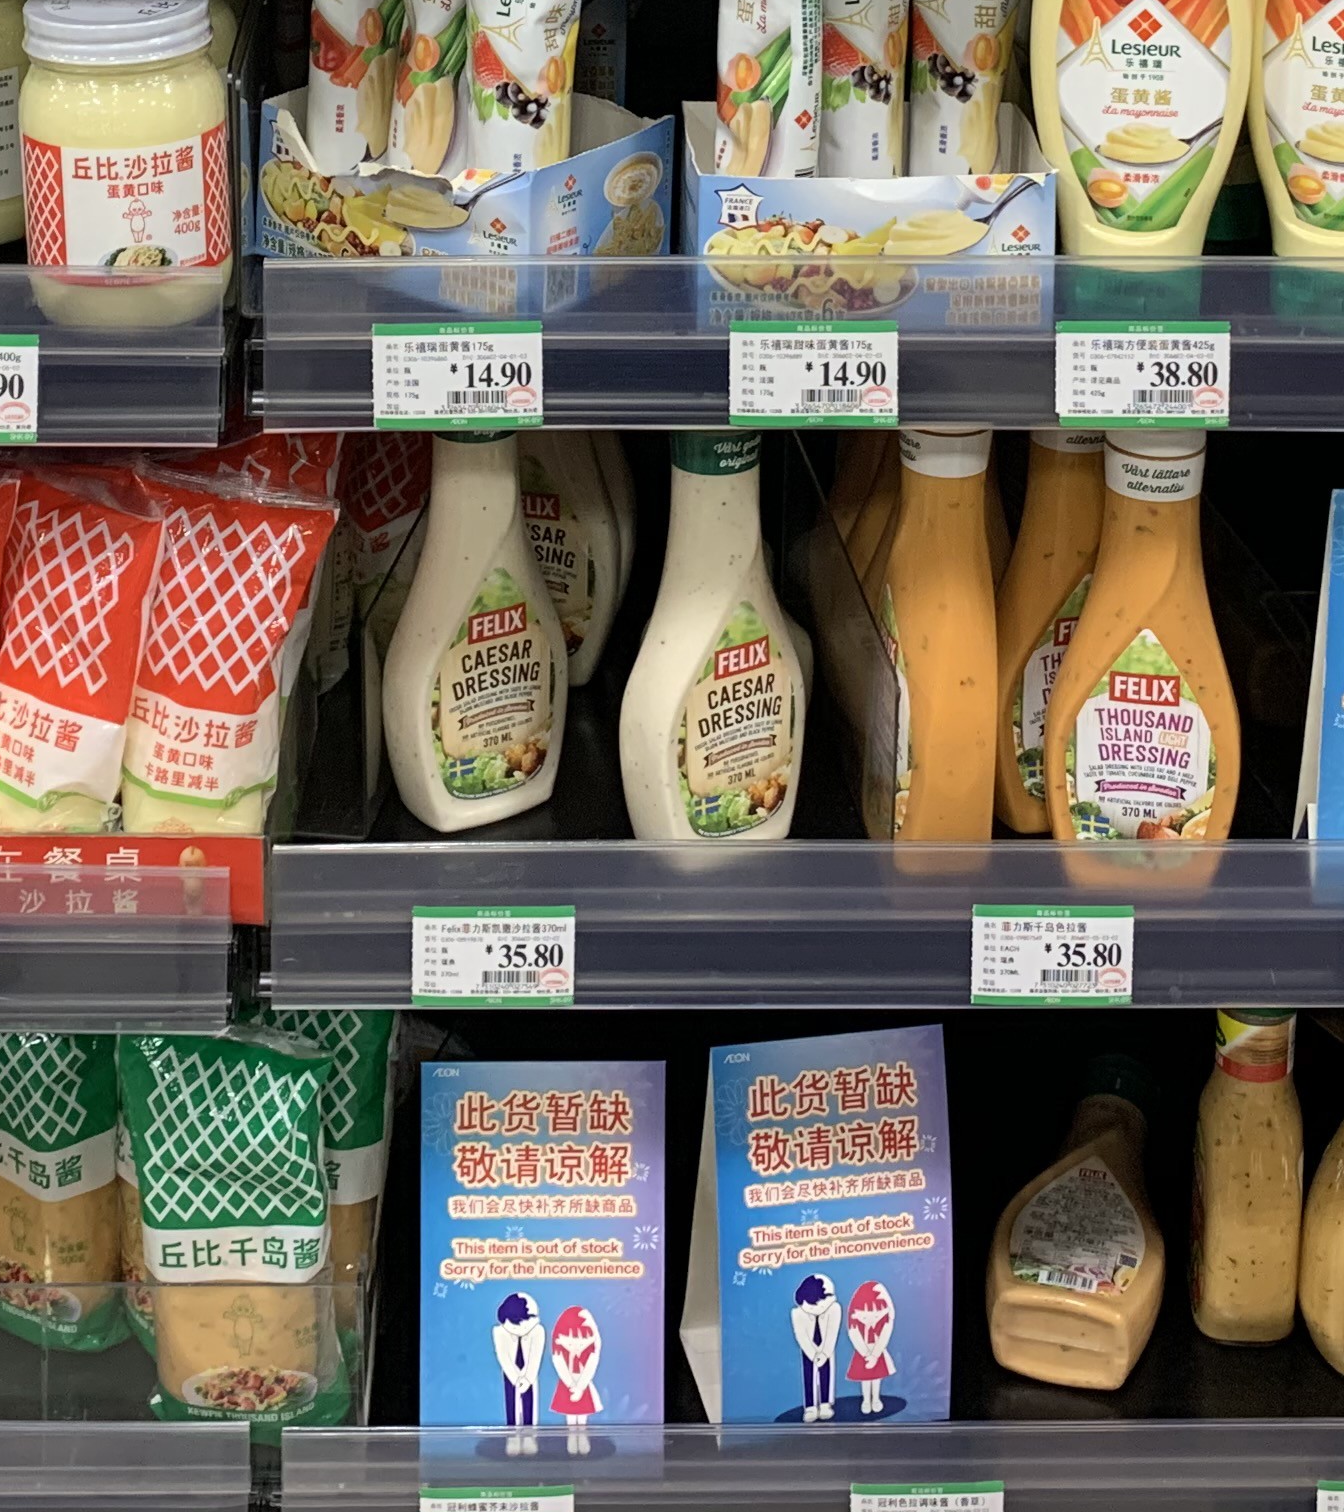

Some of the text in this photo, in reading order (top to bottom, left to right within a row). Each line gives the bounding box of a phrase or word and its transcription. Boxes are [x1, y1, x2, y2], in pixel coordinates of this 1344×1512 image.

[1111, 88, 1173, 107] 蛋黄酱
[107, 181, 165, 199] 蛋黄口味
[1123, 171, 1160, 185] 柔滑香浓
[724, 196, 754, 207] FRANCE
[404, 342, 494, 355] 乐禧瑞蛋黄酱175g
[759, 339, 873, 353] 乐禧瑞甜味蛋黄酱175g
[464, 360, 532, 388] 14.90
[820, 360, 887, 387] 14.90
[1150, 361, 1218, 387] 38.80
[471, 607, 525, 639] FELIX
[461, 640, 533, 674] CAESAR
[452, 663, 541, 701] DRESSING
[1094, 707, 1194, 734] THOUSAND
[1100, 730, 1189, 747] ISLAND LIGHT
[145, 761, 220, 791] 卡路里减半
[498, 943, 564, 969] 35.80
[1058, 942, 1122, 968] 35.80
[750, 1064, 916, 1119] 此货暂缺
[456, 1093, 631, 1135] 此货暂缺
[751, 1119, 918, 1172] 敬请谅解
[456, 1144, 631, 1185] 敬请谅解
[748, 1172, 924, 1204] 我们会尽快补齐所缺商品
[452, 1197, 634, 1216] 我们会尽快补齐所缺商品
[456, 1240, 619, 1256] This item is out of stock
[444, 1262, 640, 1278] Sorry for the inconvenience
